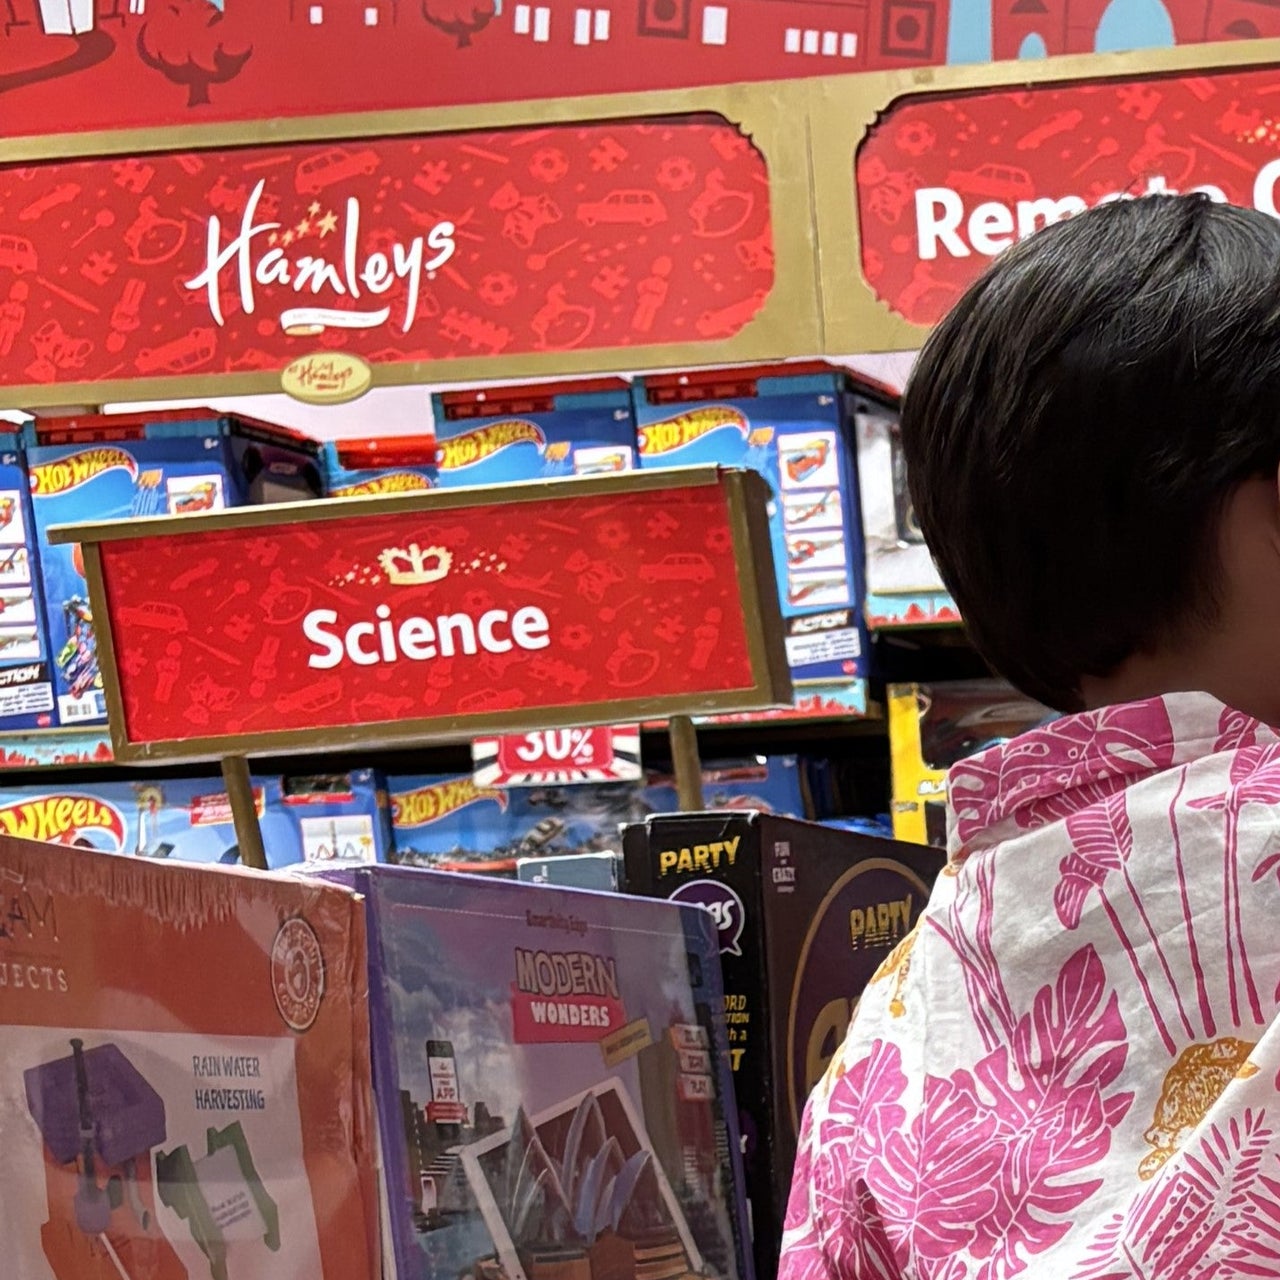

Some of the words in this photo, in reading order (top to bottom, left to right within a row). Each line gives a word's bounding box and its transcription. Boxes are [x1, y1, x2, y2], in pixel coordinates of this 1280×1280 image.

[915, 176, 1228, 259] Rem
[185, 179, 456, 333] Hamleys
[302, 604, 551, 671] Science
[659, 836, 741, 876] PARTY
[513, 946, 620, 999] MODERN
[530, 1001, 610, 1028] WONDERS
[192, 1056, 222, 1077] RAIN
[223, 1056, 260, 1078] WATER
[194, 1089, 265, 1110] HARVESTING
